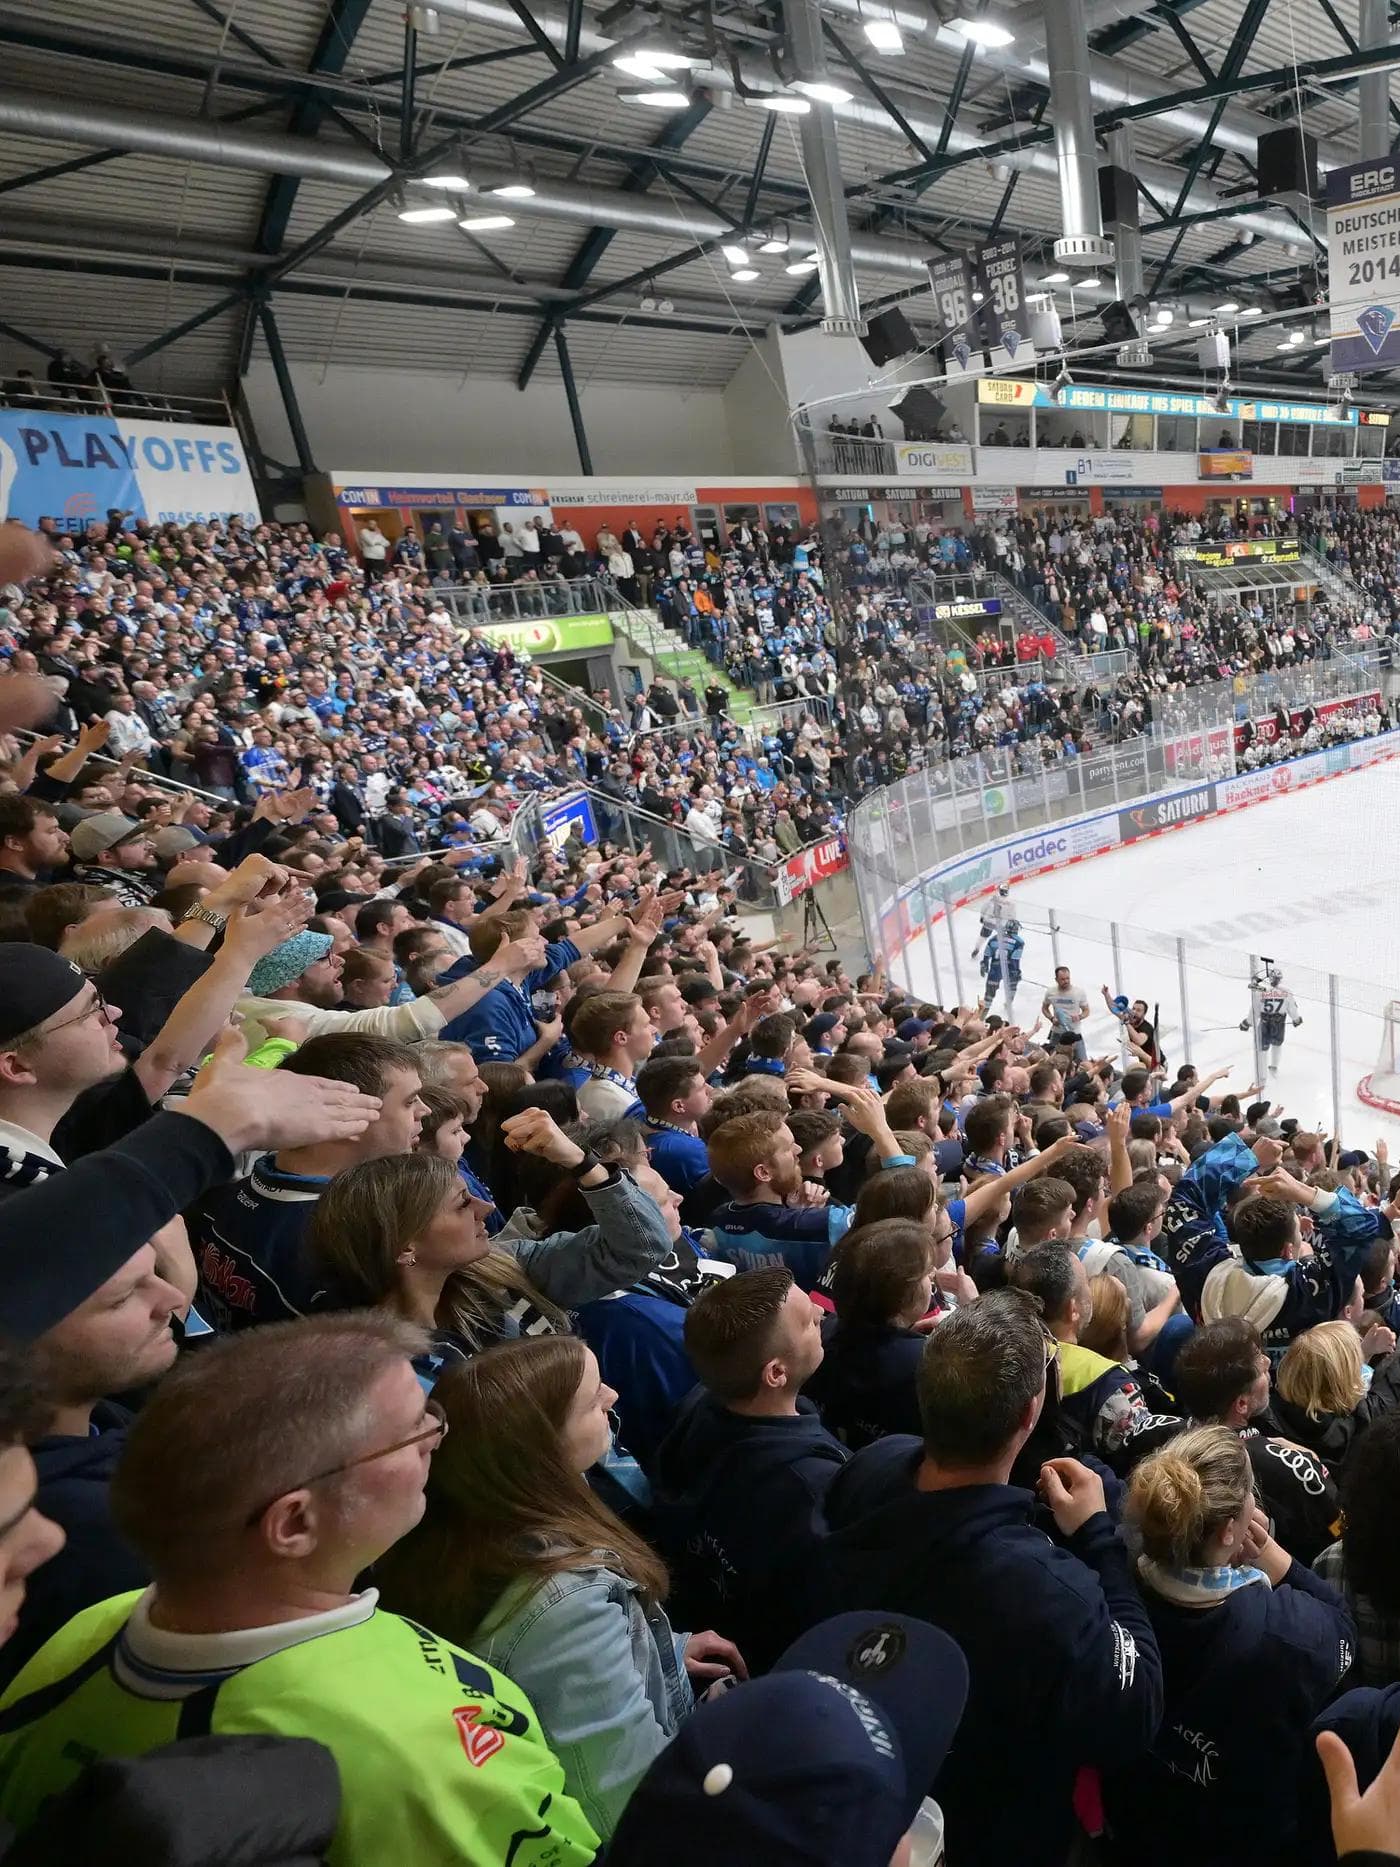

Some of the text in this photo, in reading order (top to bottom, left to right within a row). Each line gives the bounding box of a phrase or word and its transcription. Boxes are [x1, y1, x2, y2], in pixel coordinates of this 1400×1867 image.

[1350, 166, 1396, 192] ERC
[990, 273, 1020, 316] 38
[941, 289, 969, 328] 96
[995, 391, 1013, 402] CARD
[1070, 390, 1106, 407] JEDEM
[17, 427, 242, 475] PLAYOFFS
[907, 452, 968, 468] DIGIVEST
[341, 487, 380, 506] COMIN
[512, 490, 545, 505] COMIN
[587, 489, 696, 505] schreinerei-mayr.de
[835, 489, 869, 501] SATURN
[885, 488, 917, 501] SATURN
[931, 487, 961, 499] SATURN
[1157, 790, 1210, 825] SATURN
[1007, 836, 1068, 869] leadec
[1263, 998, 1285, 1013] 57
